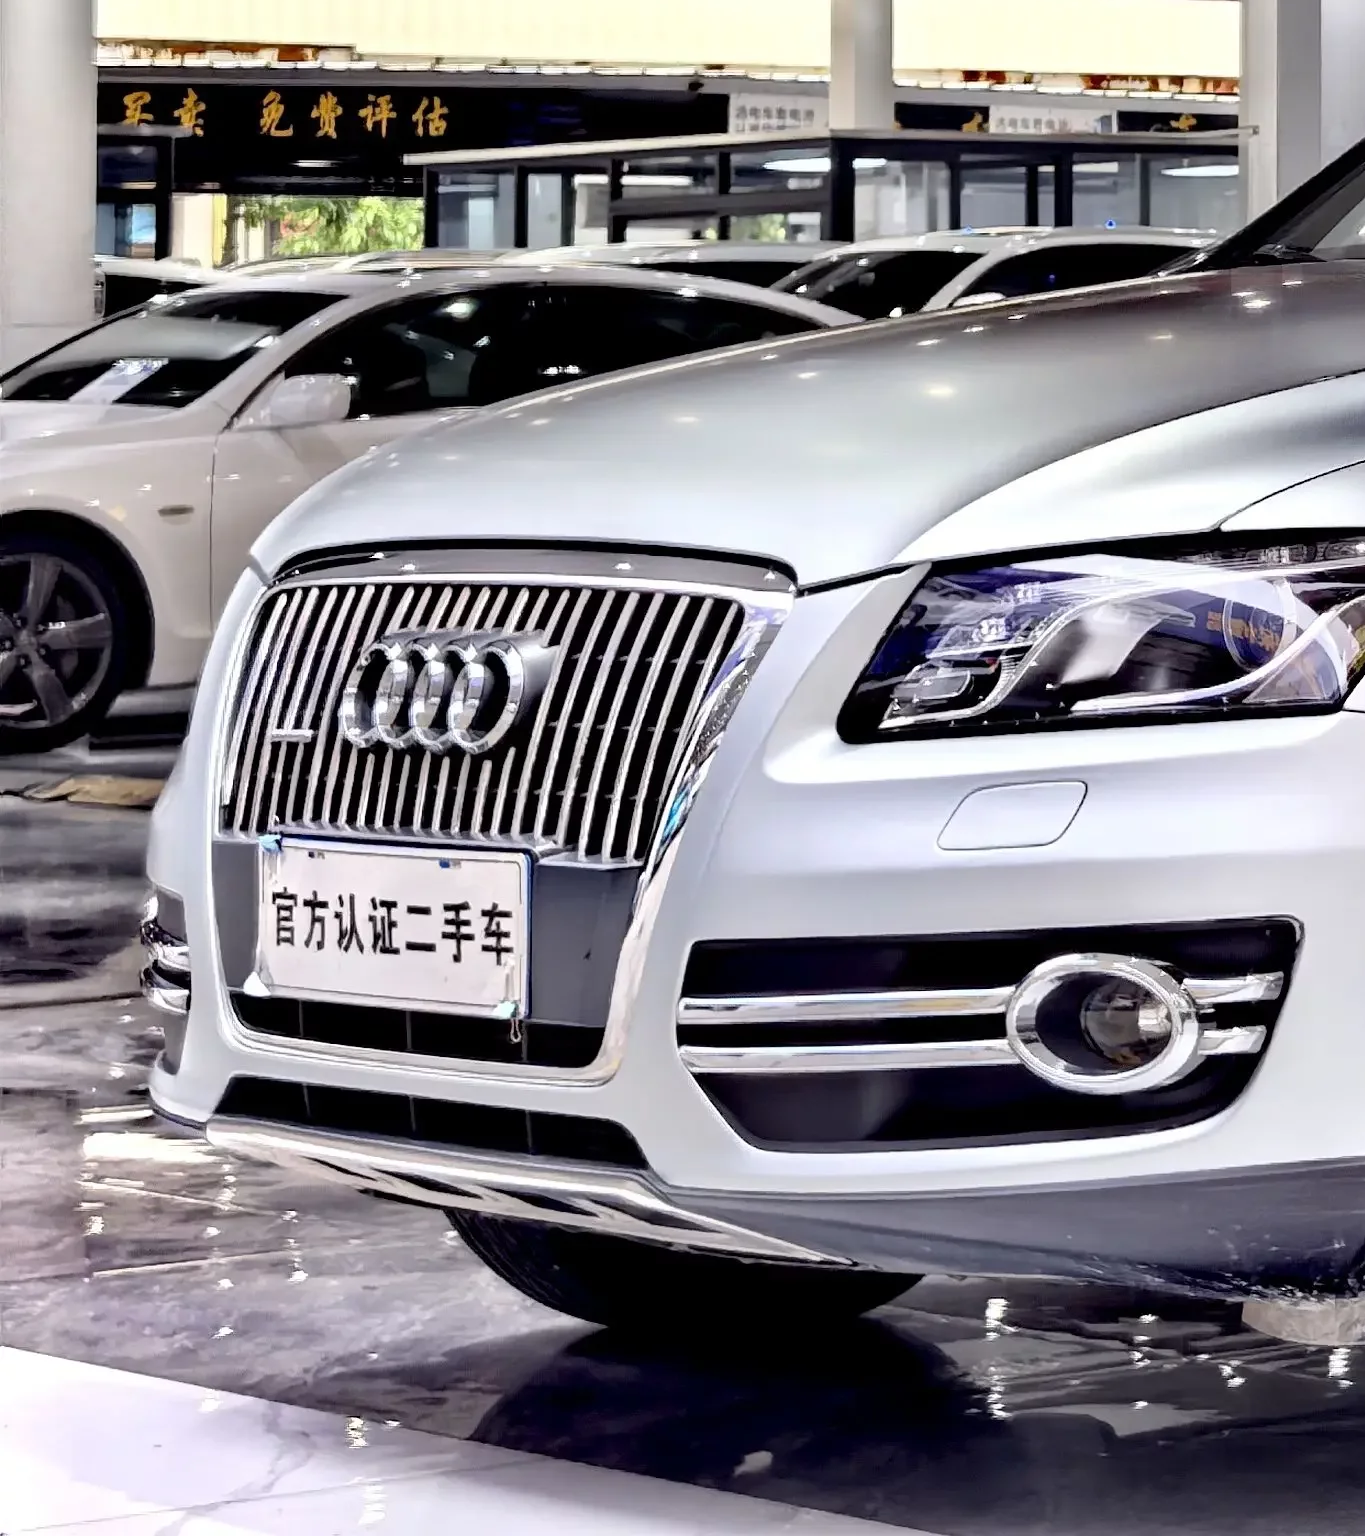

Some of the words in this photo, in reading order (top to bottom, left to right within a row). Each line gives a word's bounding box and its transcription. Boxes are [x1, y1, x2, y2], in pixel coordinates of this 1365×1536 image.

[272, 887, 514, 966] 官方认证二手车
